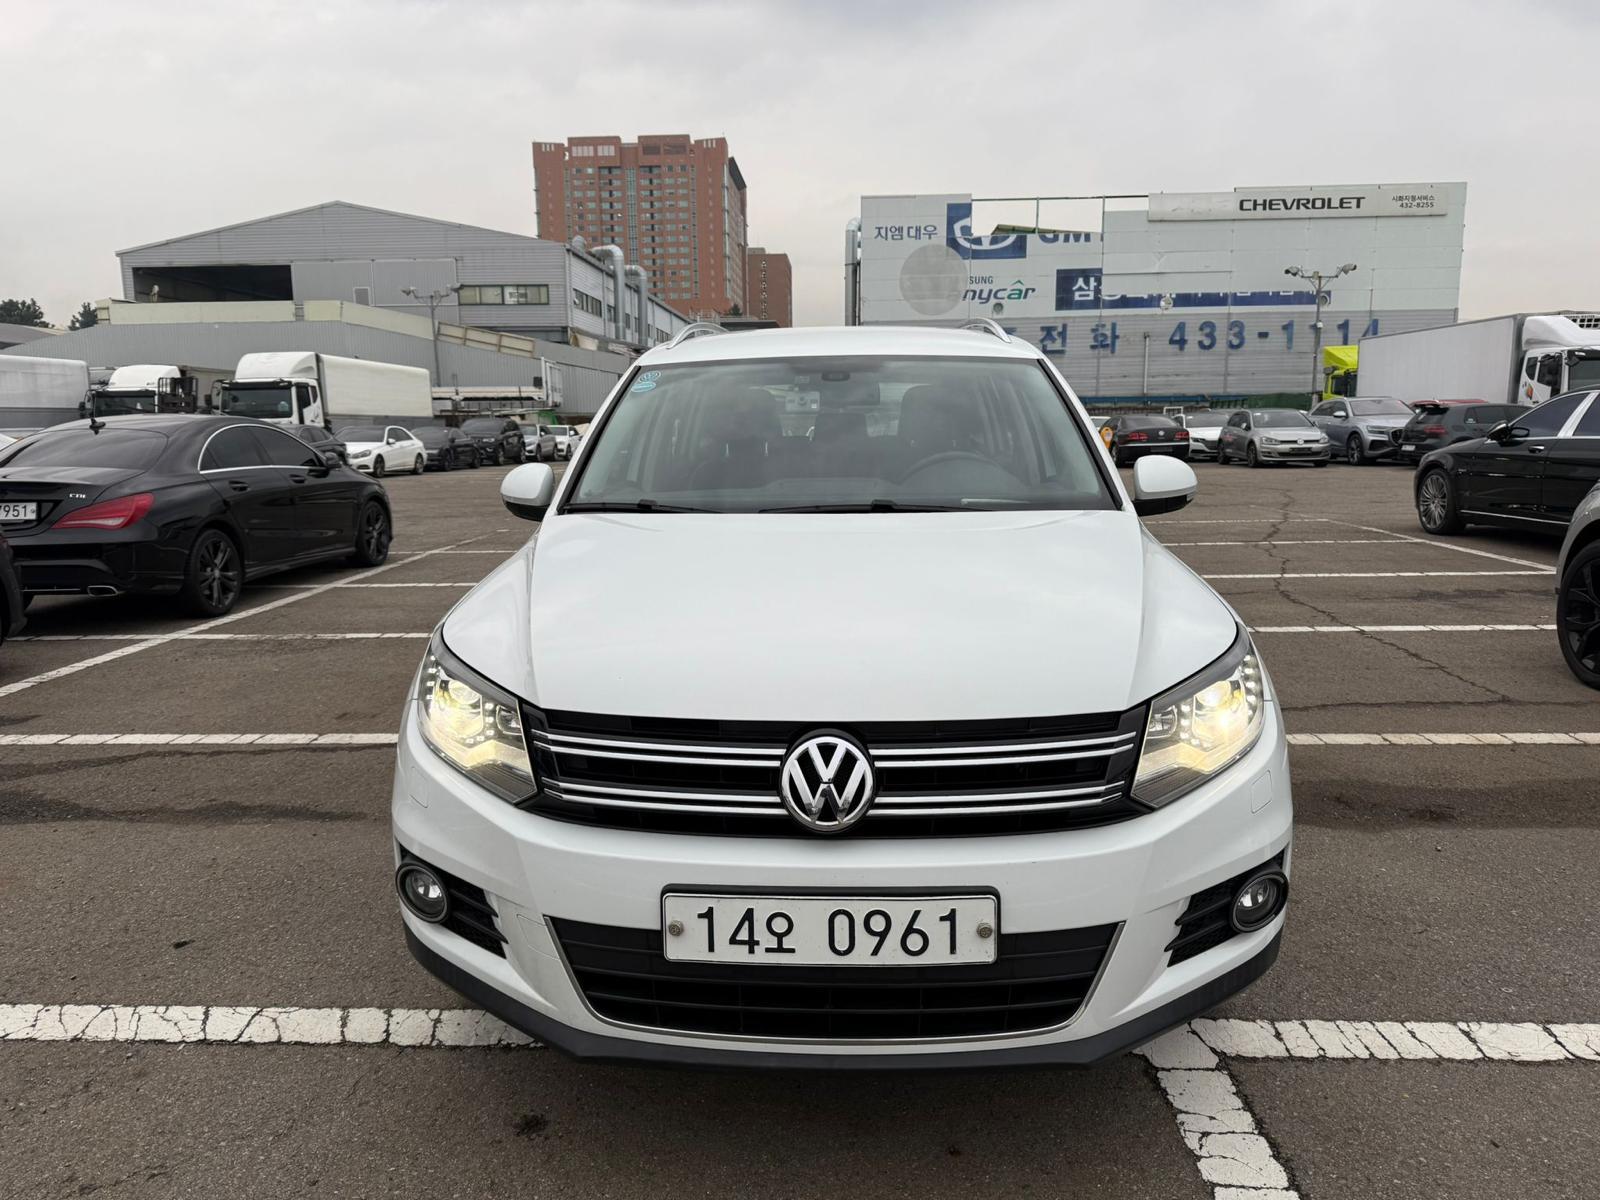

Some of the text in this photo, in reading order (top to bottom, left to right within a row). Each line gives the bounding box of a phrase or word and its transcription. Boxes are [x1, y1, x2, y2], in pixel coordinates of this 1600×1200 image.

[1239, 196, 1366, 211] CHEVROLET
[874, 224, 939, 241] 지엠대우
[0, 504, 28, 518] 951
[697, 906, 958, 957] 14오 0961
